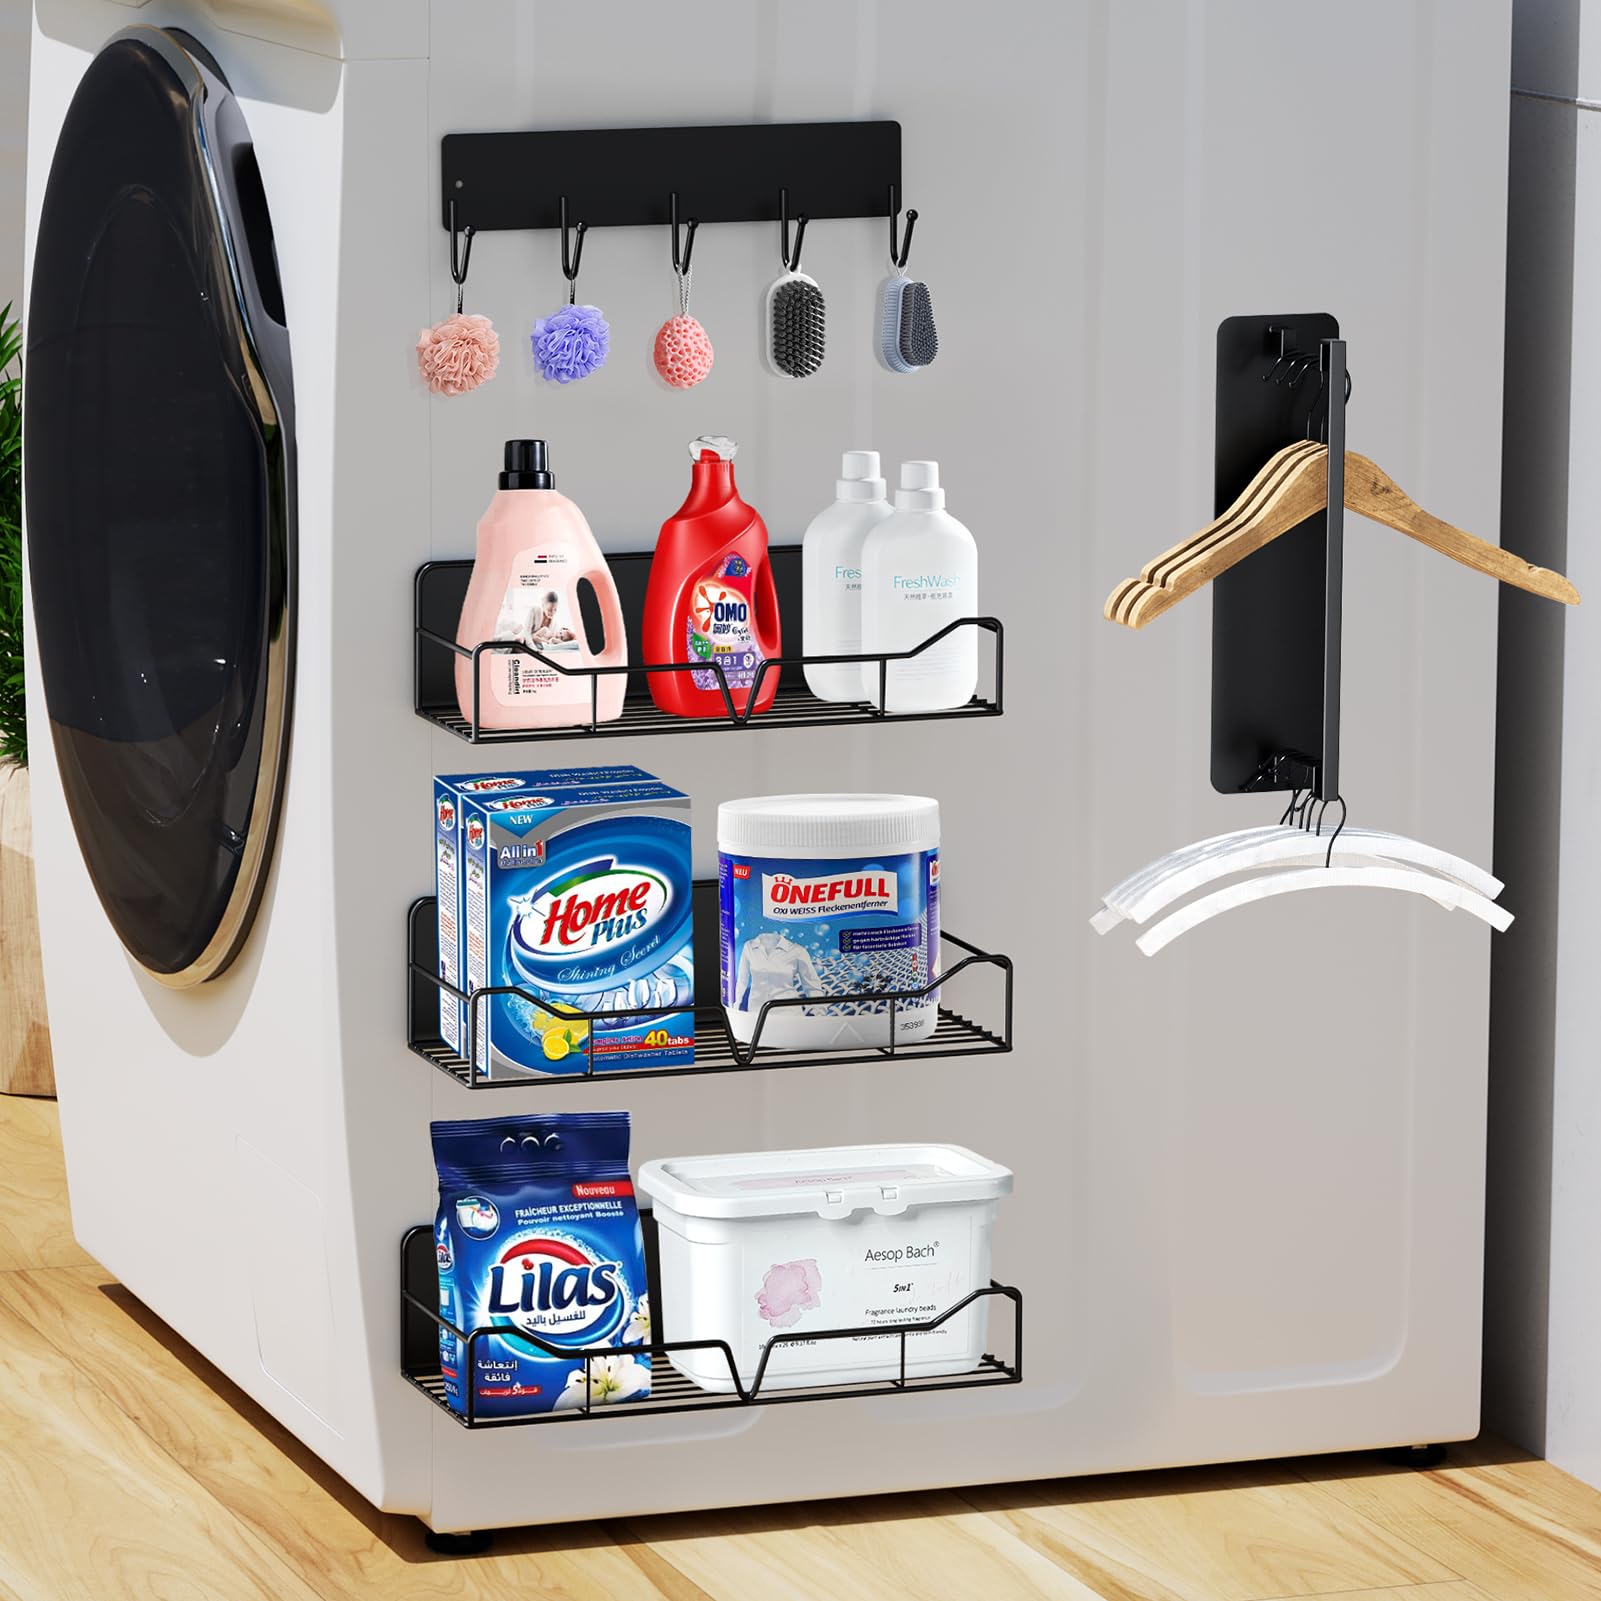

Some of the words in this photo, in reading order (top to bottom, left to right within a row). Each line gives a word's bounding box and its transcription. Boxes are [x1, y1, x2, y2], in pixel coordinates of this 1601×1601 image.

[893, 575, 960, 589] FreshWash
[714, 602, 748, 622] OMO
[473, 779, 516, 790] Home
[502, 798, 545, 810] Home
[510, 815, 533, 824] NEW
[500, 844, 520, 859] All
[734, 867, 748, 876] NEU
[539, 881, 651, 946] Home
[773, 906, 788, 915] OXI
[789, 906, 816, 915] WEISS
[817, 900, 889, 914] Fleckenentferner
[591, 908, 648, 946] Plus
[557, 963, 615, 985] Shining
[620, 933, 660, 968] Secret
[576, 1184, 616, 1196] Nouveau
[559, 1200, 623, 1214] EXCEPTIONNELLE
[517, 1216, 550, 1226] Pouvoir
[552, 1212, 594, 1223] nettoyant
[865, 1249, 903, 1263] Aesop
[488, 1257, 618, 1314] Lilas
[865, 1307, 895, 1317] Fragrance
[896, 1305, 918, 1315] laundry
[919, 1303, 937, 1312] beads
[526, 1315, 547, 1325] باليد
[549, 1310, 586, 1325] للغسيل
